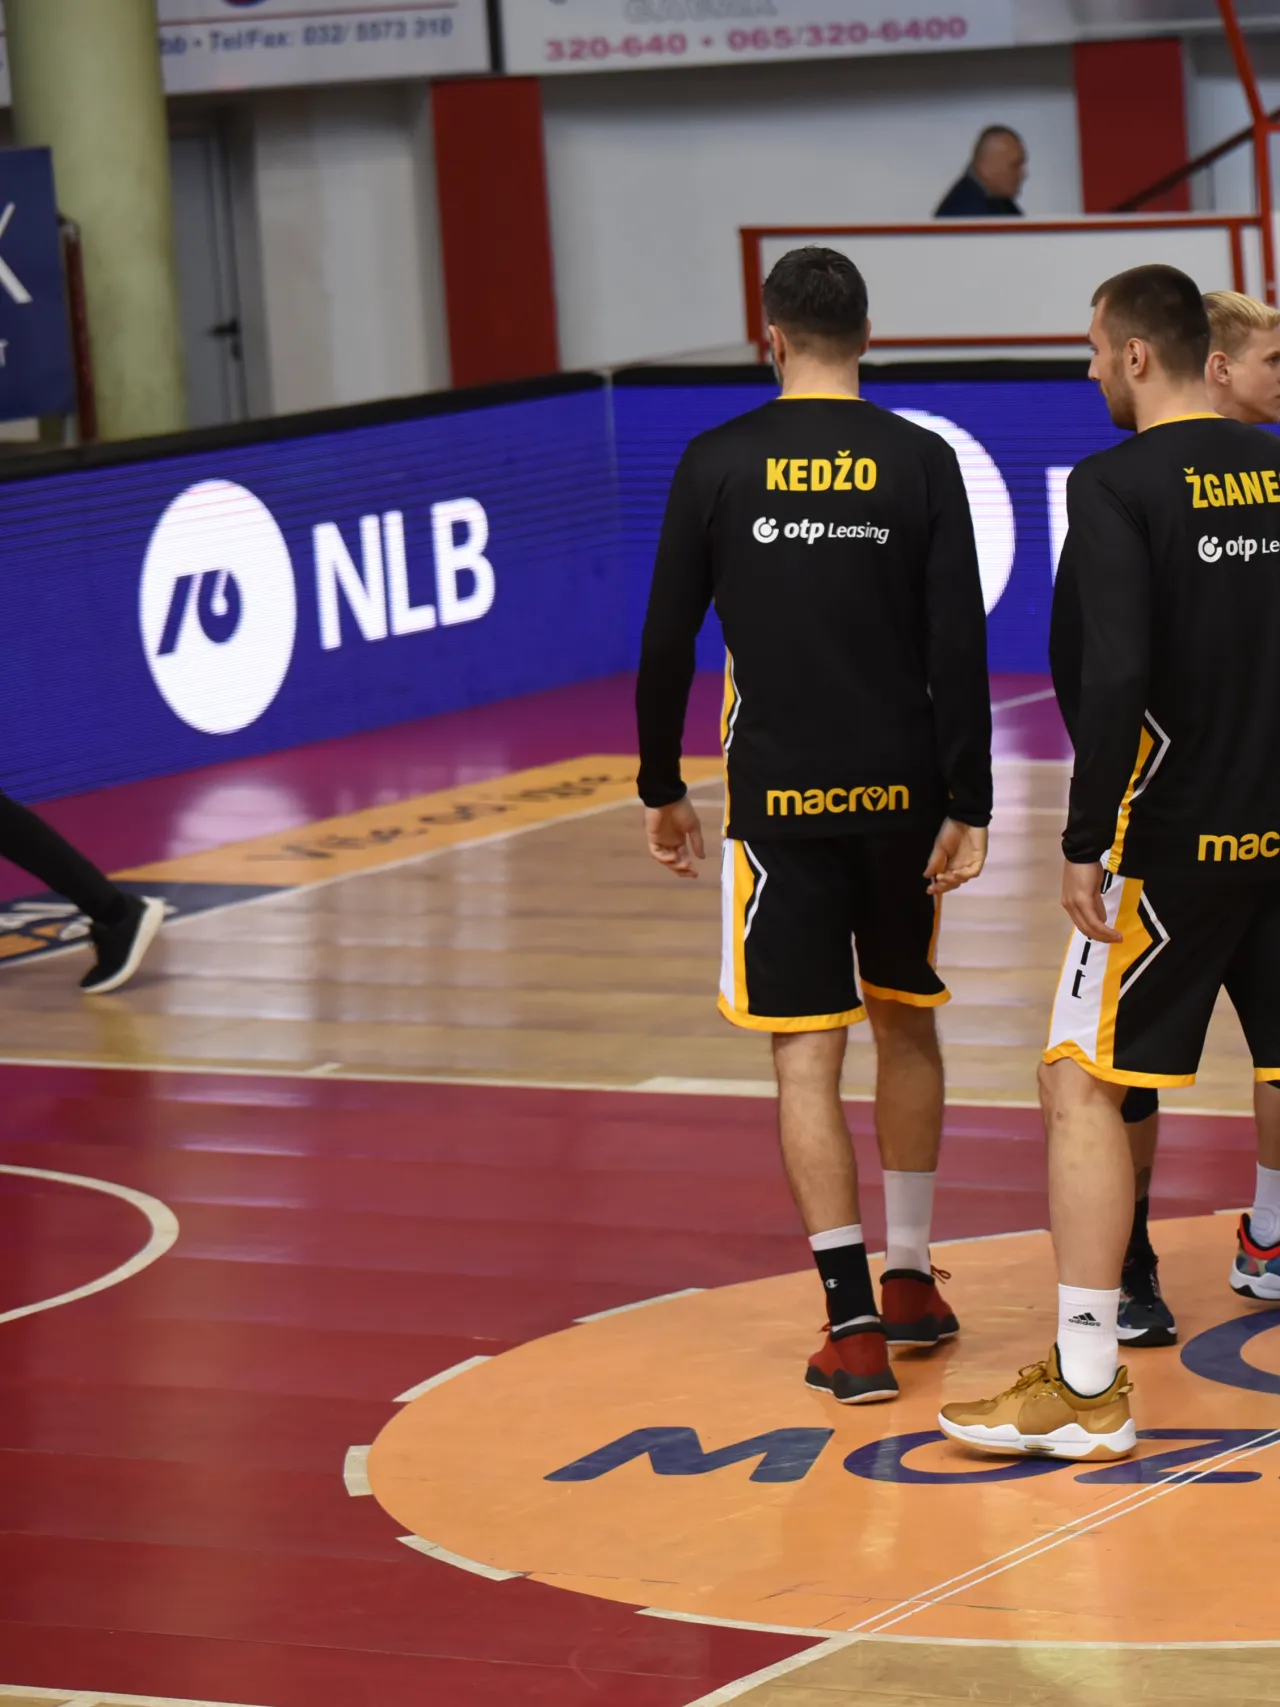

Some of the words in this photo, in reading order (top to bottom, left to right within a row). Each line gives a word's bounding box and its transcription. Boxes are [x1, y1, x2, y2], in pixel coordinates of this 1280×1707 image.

[544, 33, 687, 62] 320-640
[766, 450, 877, 491] KEDŽO
[783, 518, 825, 545] otp
[828, 522, 890, 545] Leasing
[1225, 535, 1258, 562] otp
[312, 497, 496, 651] NLB
[766, 784, 910, 816] macron
